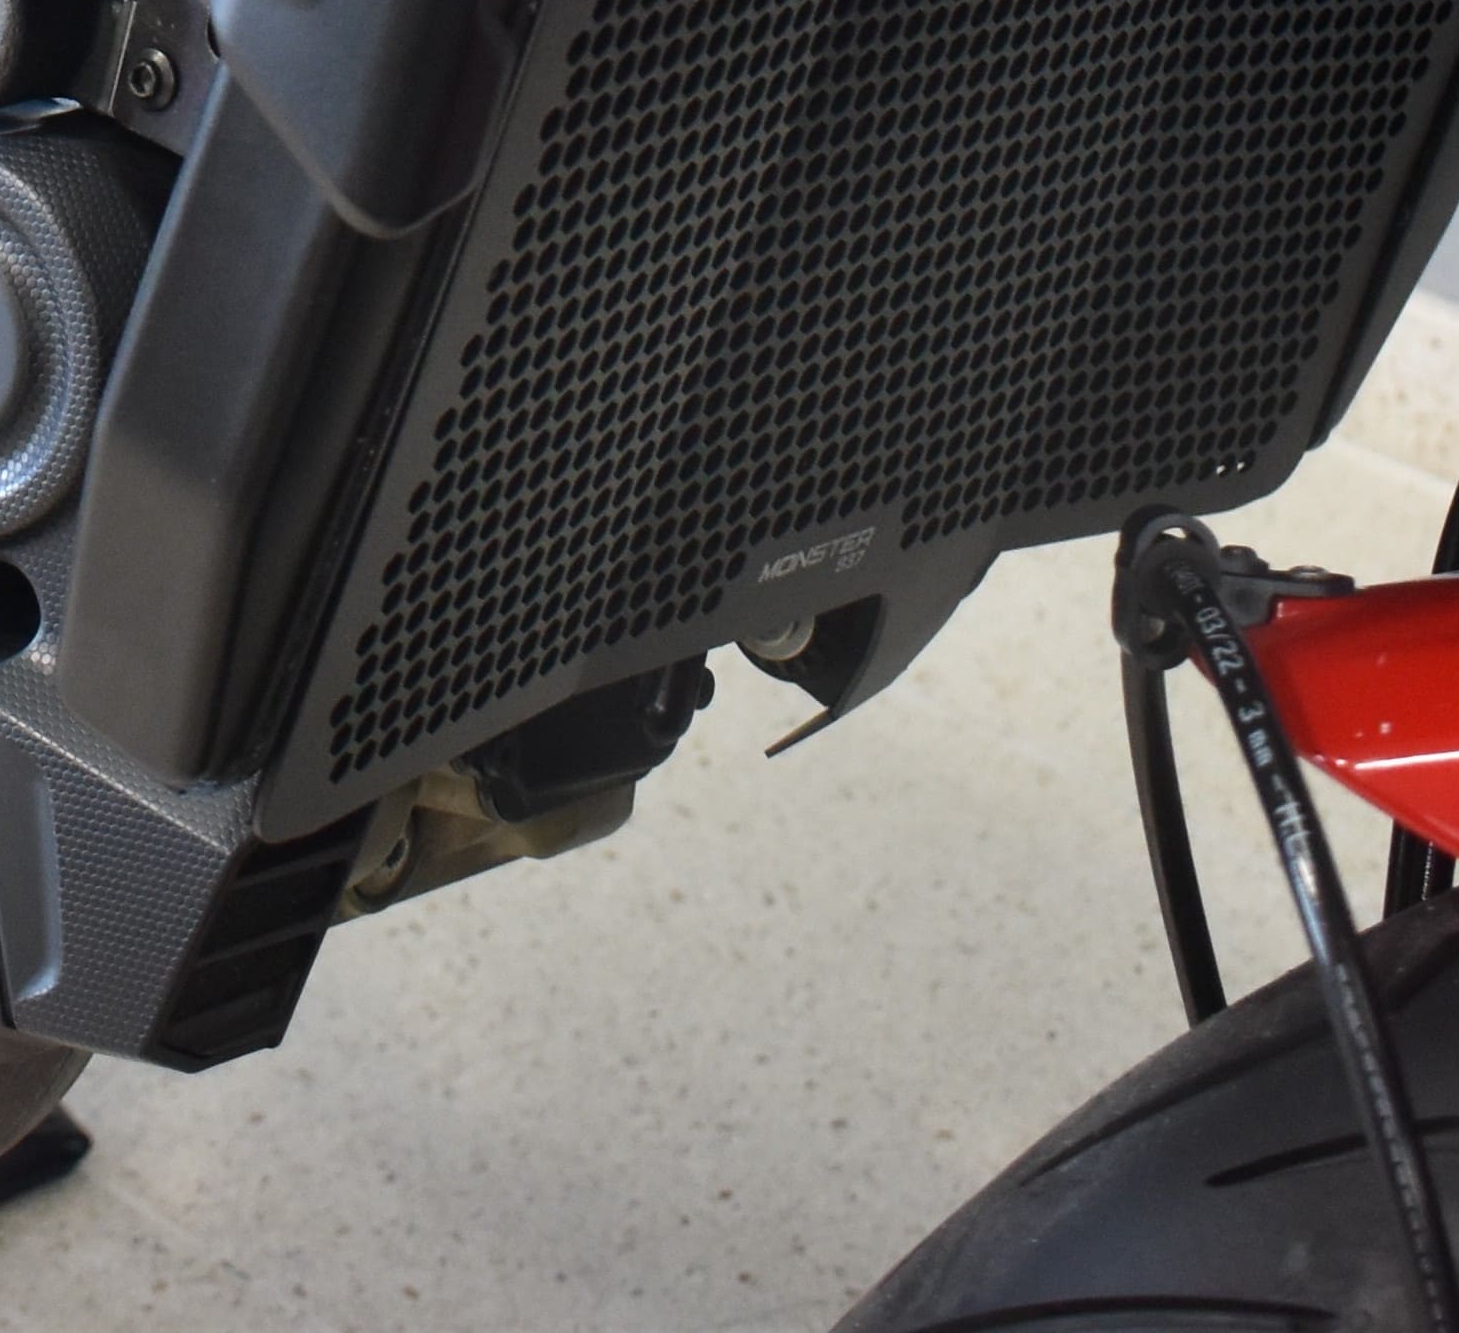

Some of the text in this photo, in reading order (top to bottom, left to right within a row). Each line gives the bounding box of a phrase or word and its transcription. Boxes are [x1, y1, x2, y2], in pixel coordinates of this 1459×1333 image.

[757, 526, 877, 584] MONSTER
[1194, 605, 1246, 677] 03/22
[1237, 699, 1266, 726] 3
